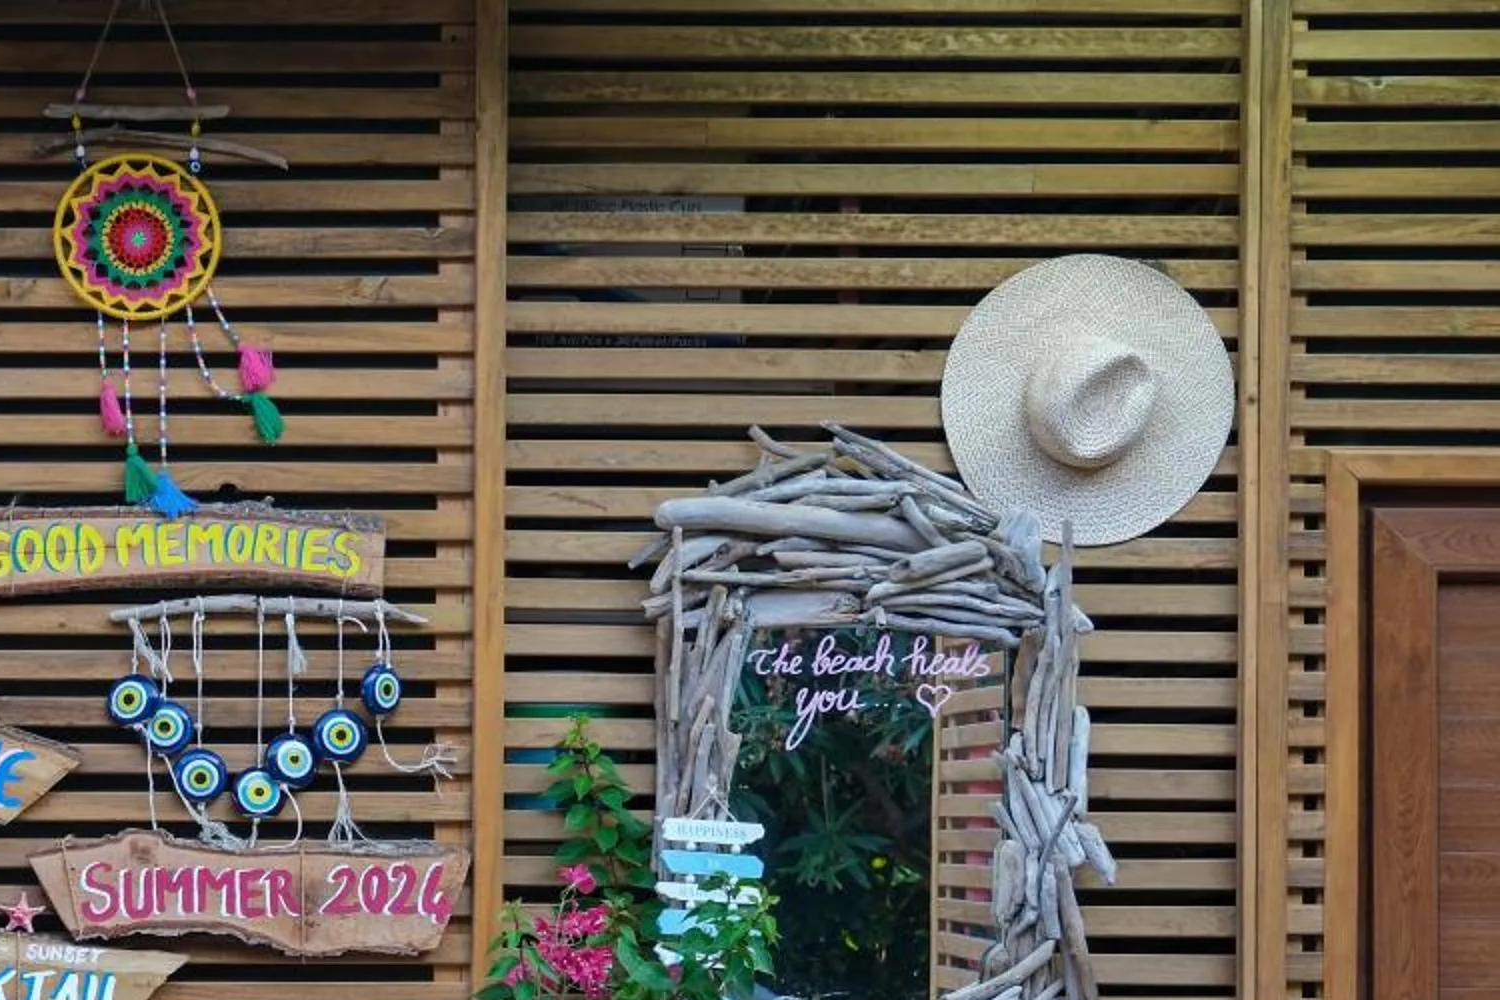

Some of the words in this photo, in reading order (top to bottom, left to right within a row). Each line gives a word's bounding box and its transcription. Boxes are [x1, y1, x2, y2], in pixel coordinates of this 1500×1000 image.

[114, 521, 361, 577] MEMORIES
[746, 644, 803, 675] The
[811, 635, 895, 677] beach
[902, 635, 991, 677] heals
[79, 862, 301, 923] SUMMER
